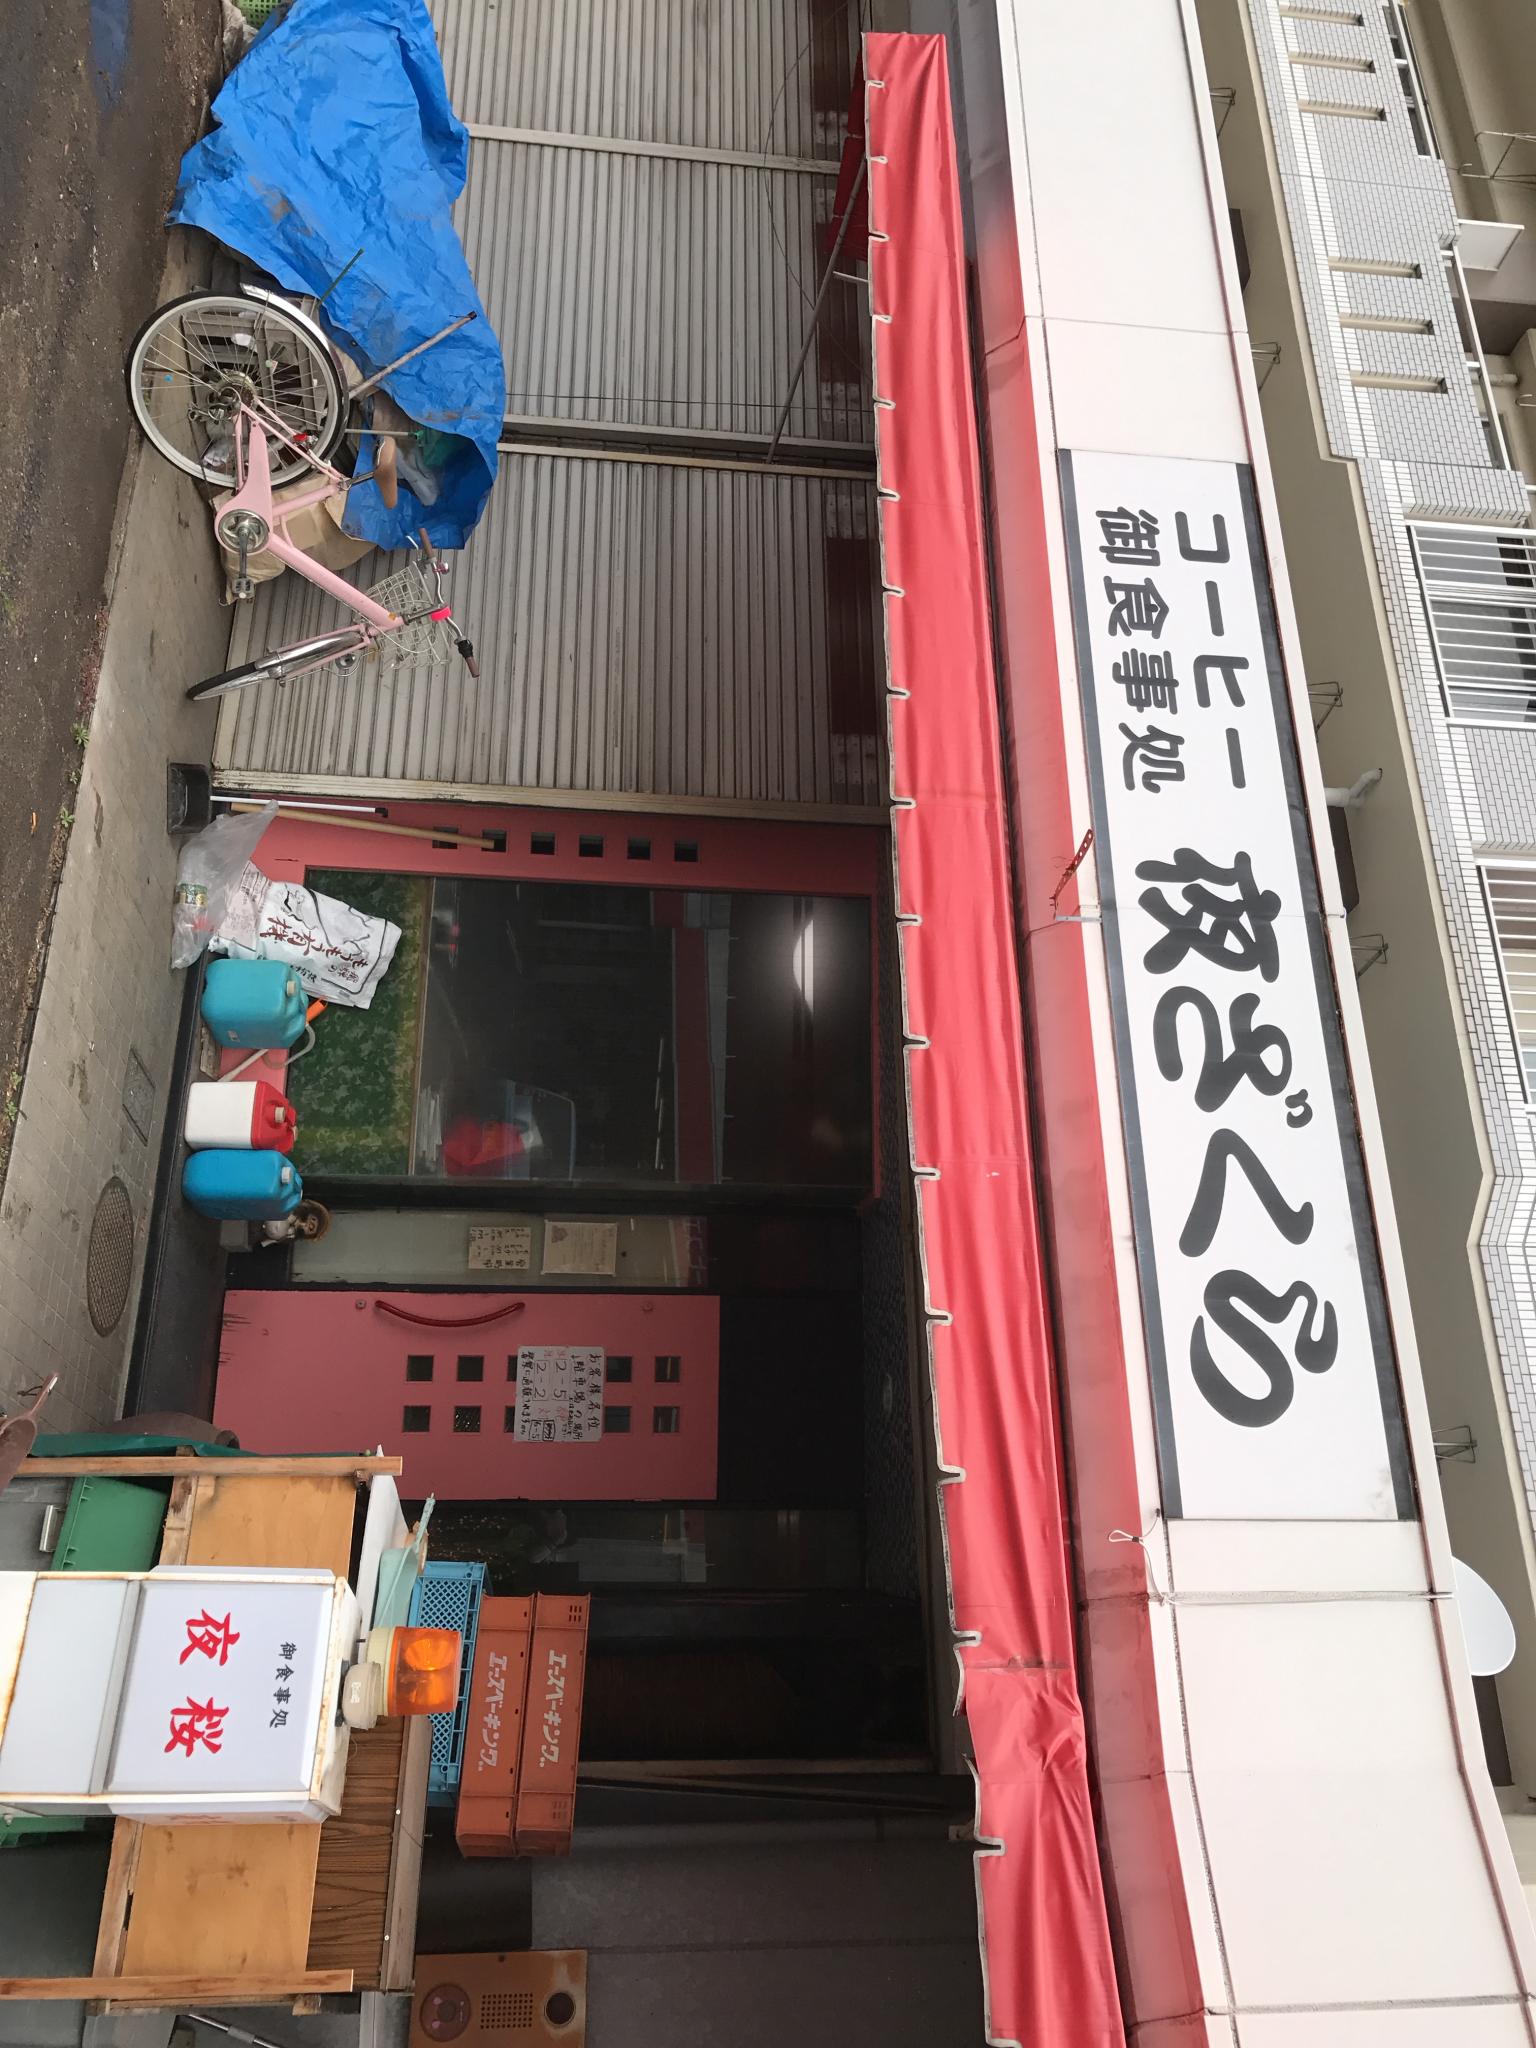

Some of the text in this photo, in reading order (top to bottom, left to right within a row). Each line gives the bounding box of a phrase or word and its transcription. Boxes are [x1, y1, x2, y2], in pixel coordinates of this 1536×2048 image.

[1095, 506, 1186, 794] 御食事処
[1174, 511, 1250, 790] コーヒー
[259, 917, 369, 969] もうもう有機
[1135, 847, 1339, 1429] 夜ざくら
[163, 1608, 241, 1759] 夜桜
[268, 1641, 298, 1729] 御食事処
